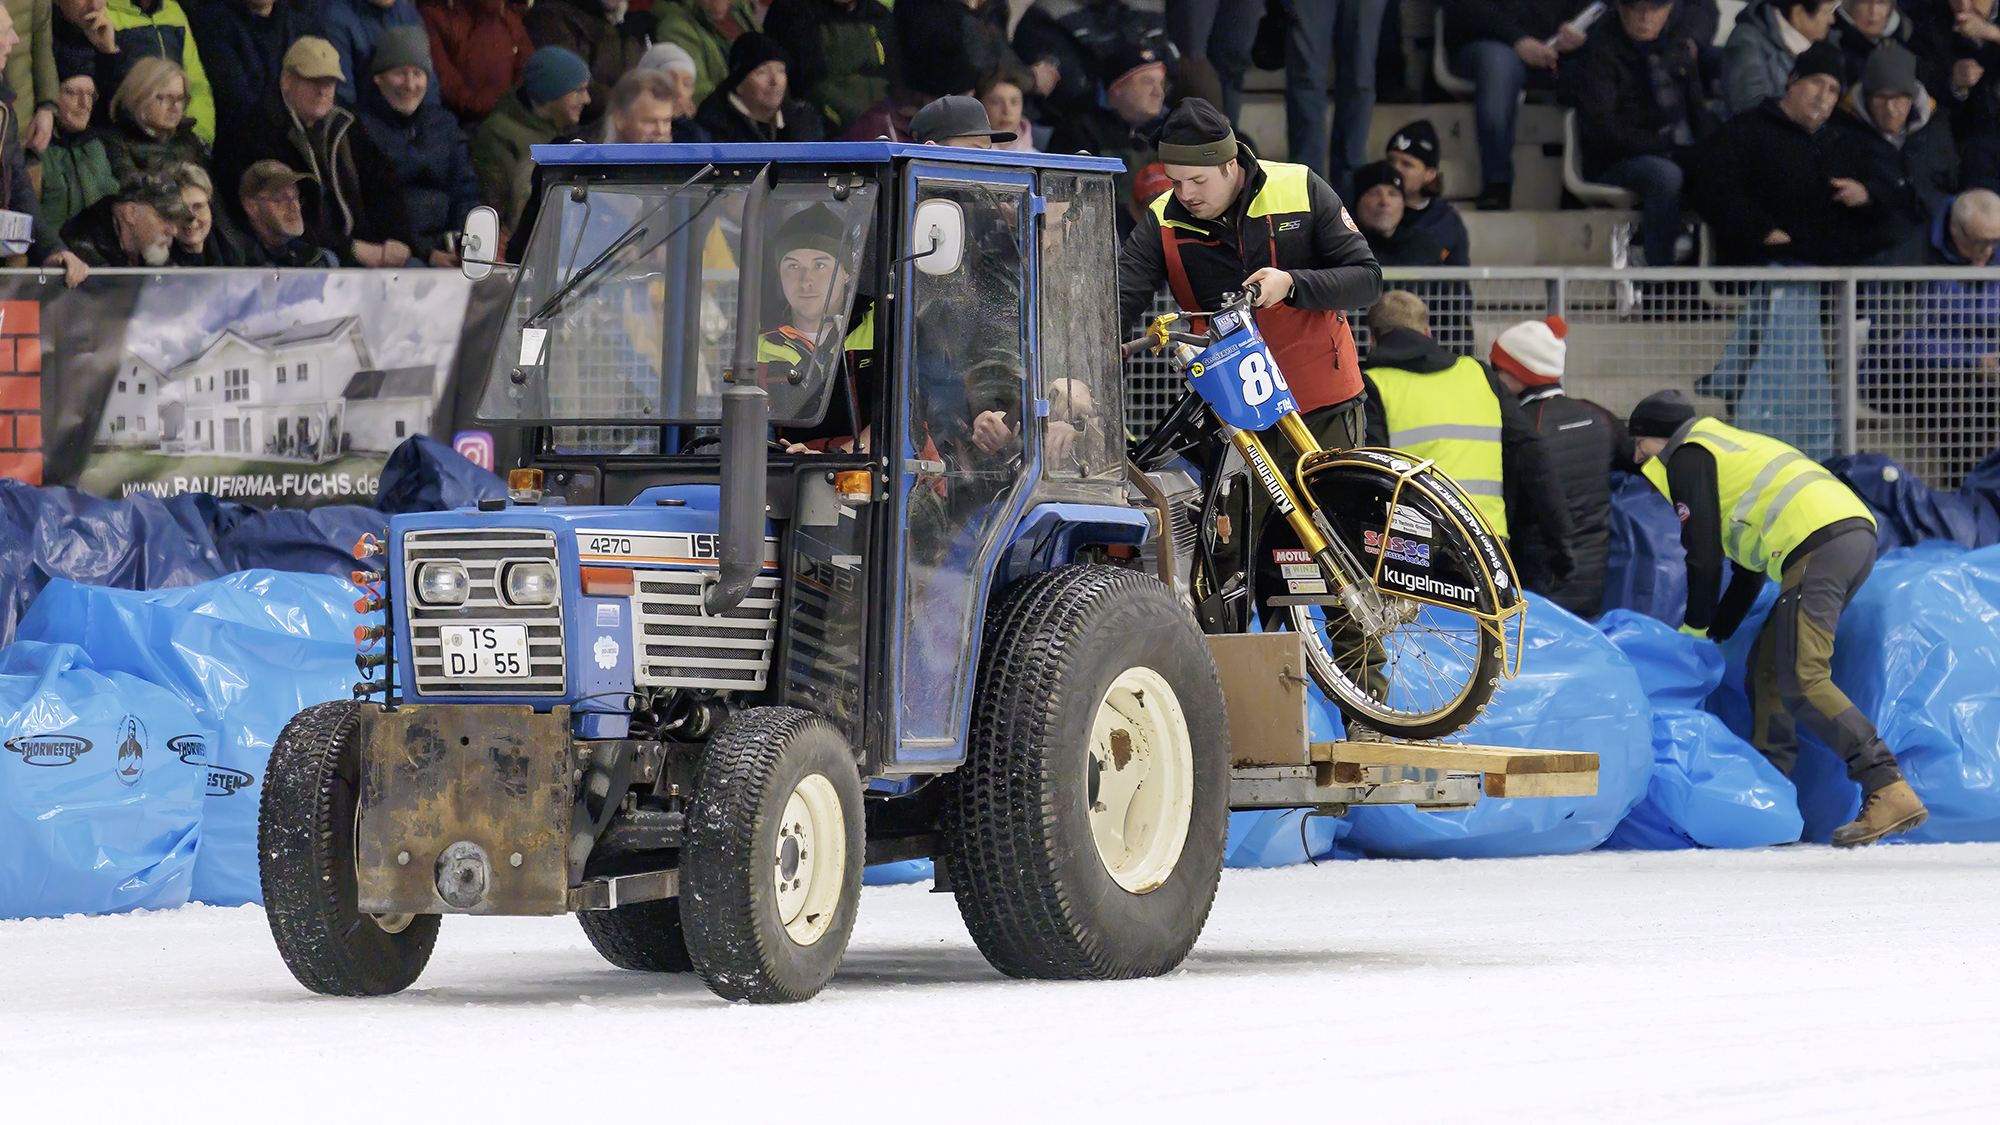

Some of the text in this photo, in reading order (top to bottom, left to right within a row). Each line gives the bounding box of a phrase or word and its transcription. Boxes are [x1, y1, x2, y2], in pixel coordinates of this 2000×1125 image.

[1275, 397, 1295, 414] FIM
[121, 472, 379, 499] www.BAUFIRMA-FUCHS.de
[590, 537, 631, 554] 4270
[1276, 551, 1311, 562] MOTUL
[1480, 536, 1502, 570] Stefan
[1384, 565, 1477, 603] kugelmann
[469, 628, 497, 650] TS
[451, 653, 520, 675] DJ 55
[20, 741, 83, 757] THORWESTEN
